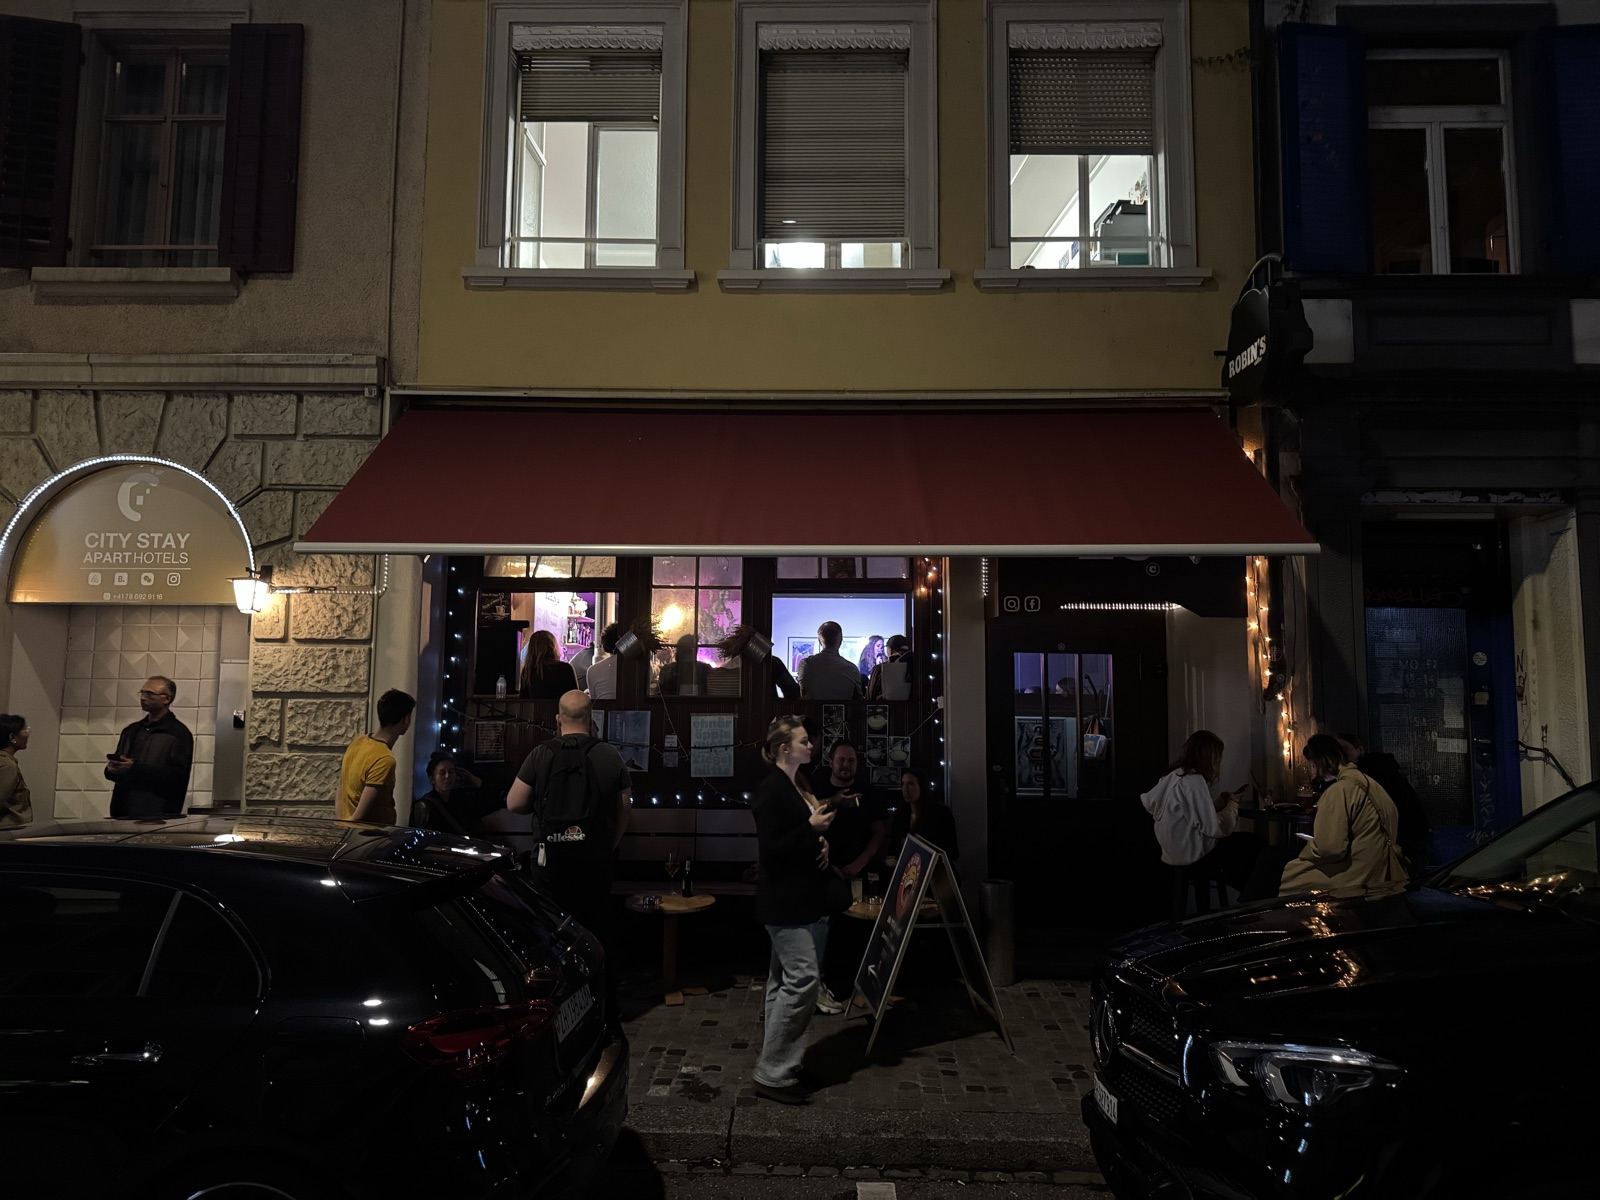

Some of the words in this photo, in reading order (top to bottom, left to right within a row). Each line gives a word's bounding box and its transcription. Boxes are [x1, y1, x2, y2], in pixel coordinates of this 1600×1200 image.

[1229, 335, 1266, 378] ROBIN'S
[84, 533, 132, 549] CITY
[136, 533, 191, 549] STAY
[83, 552, 189, 564] APARTHOTELS
[547, 833, 586, 842] ellesse
